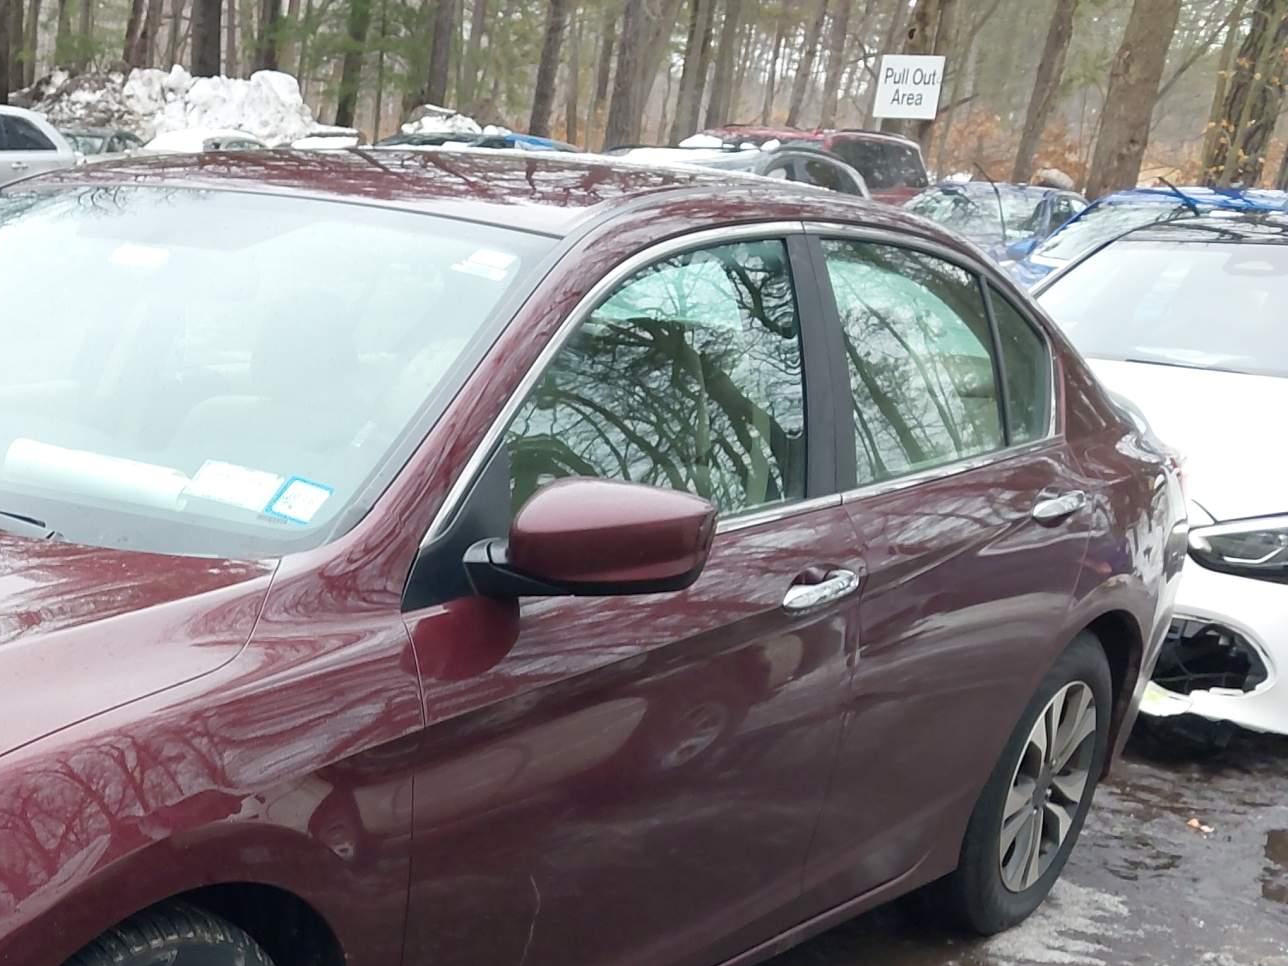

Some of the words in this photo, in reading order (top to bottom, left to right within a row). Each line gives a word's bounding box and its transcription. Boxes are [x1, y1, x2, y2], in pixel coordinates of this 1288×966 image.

[884, 67, 909, 85] Pull
[912, 68, 937, 85] Out
[890, 88, 923, 106] Area
